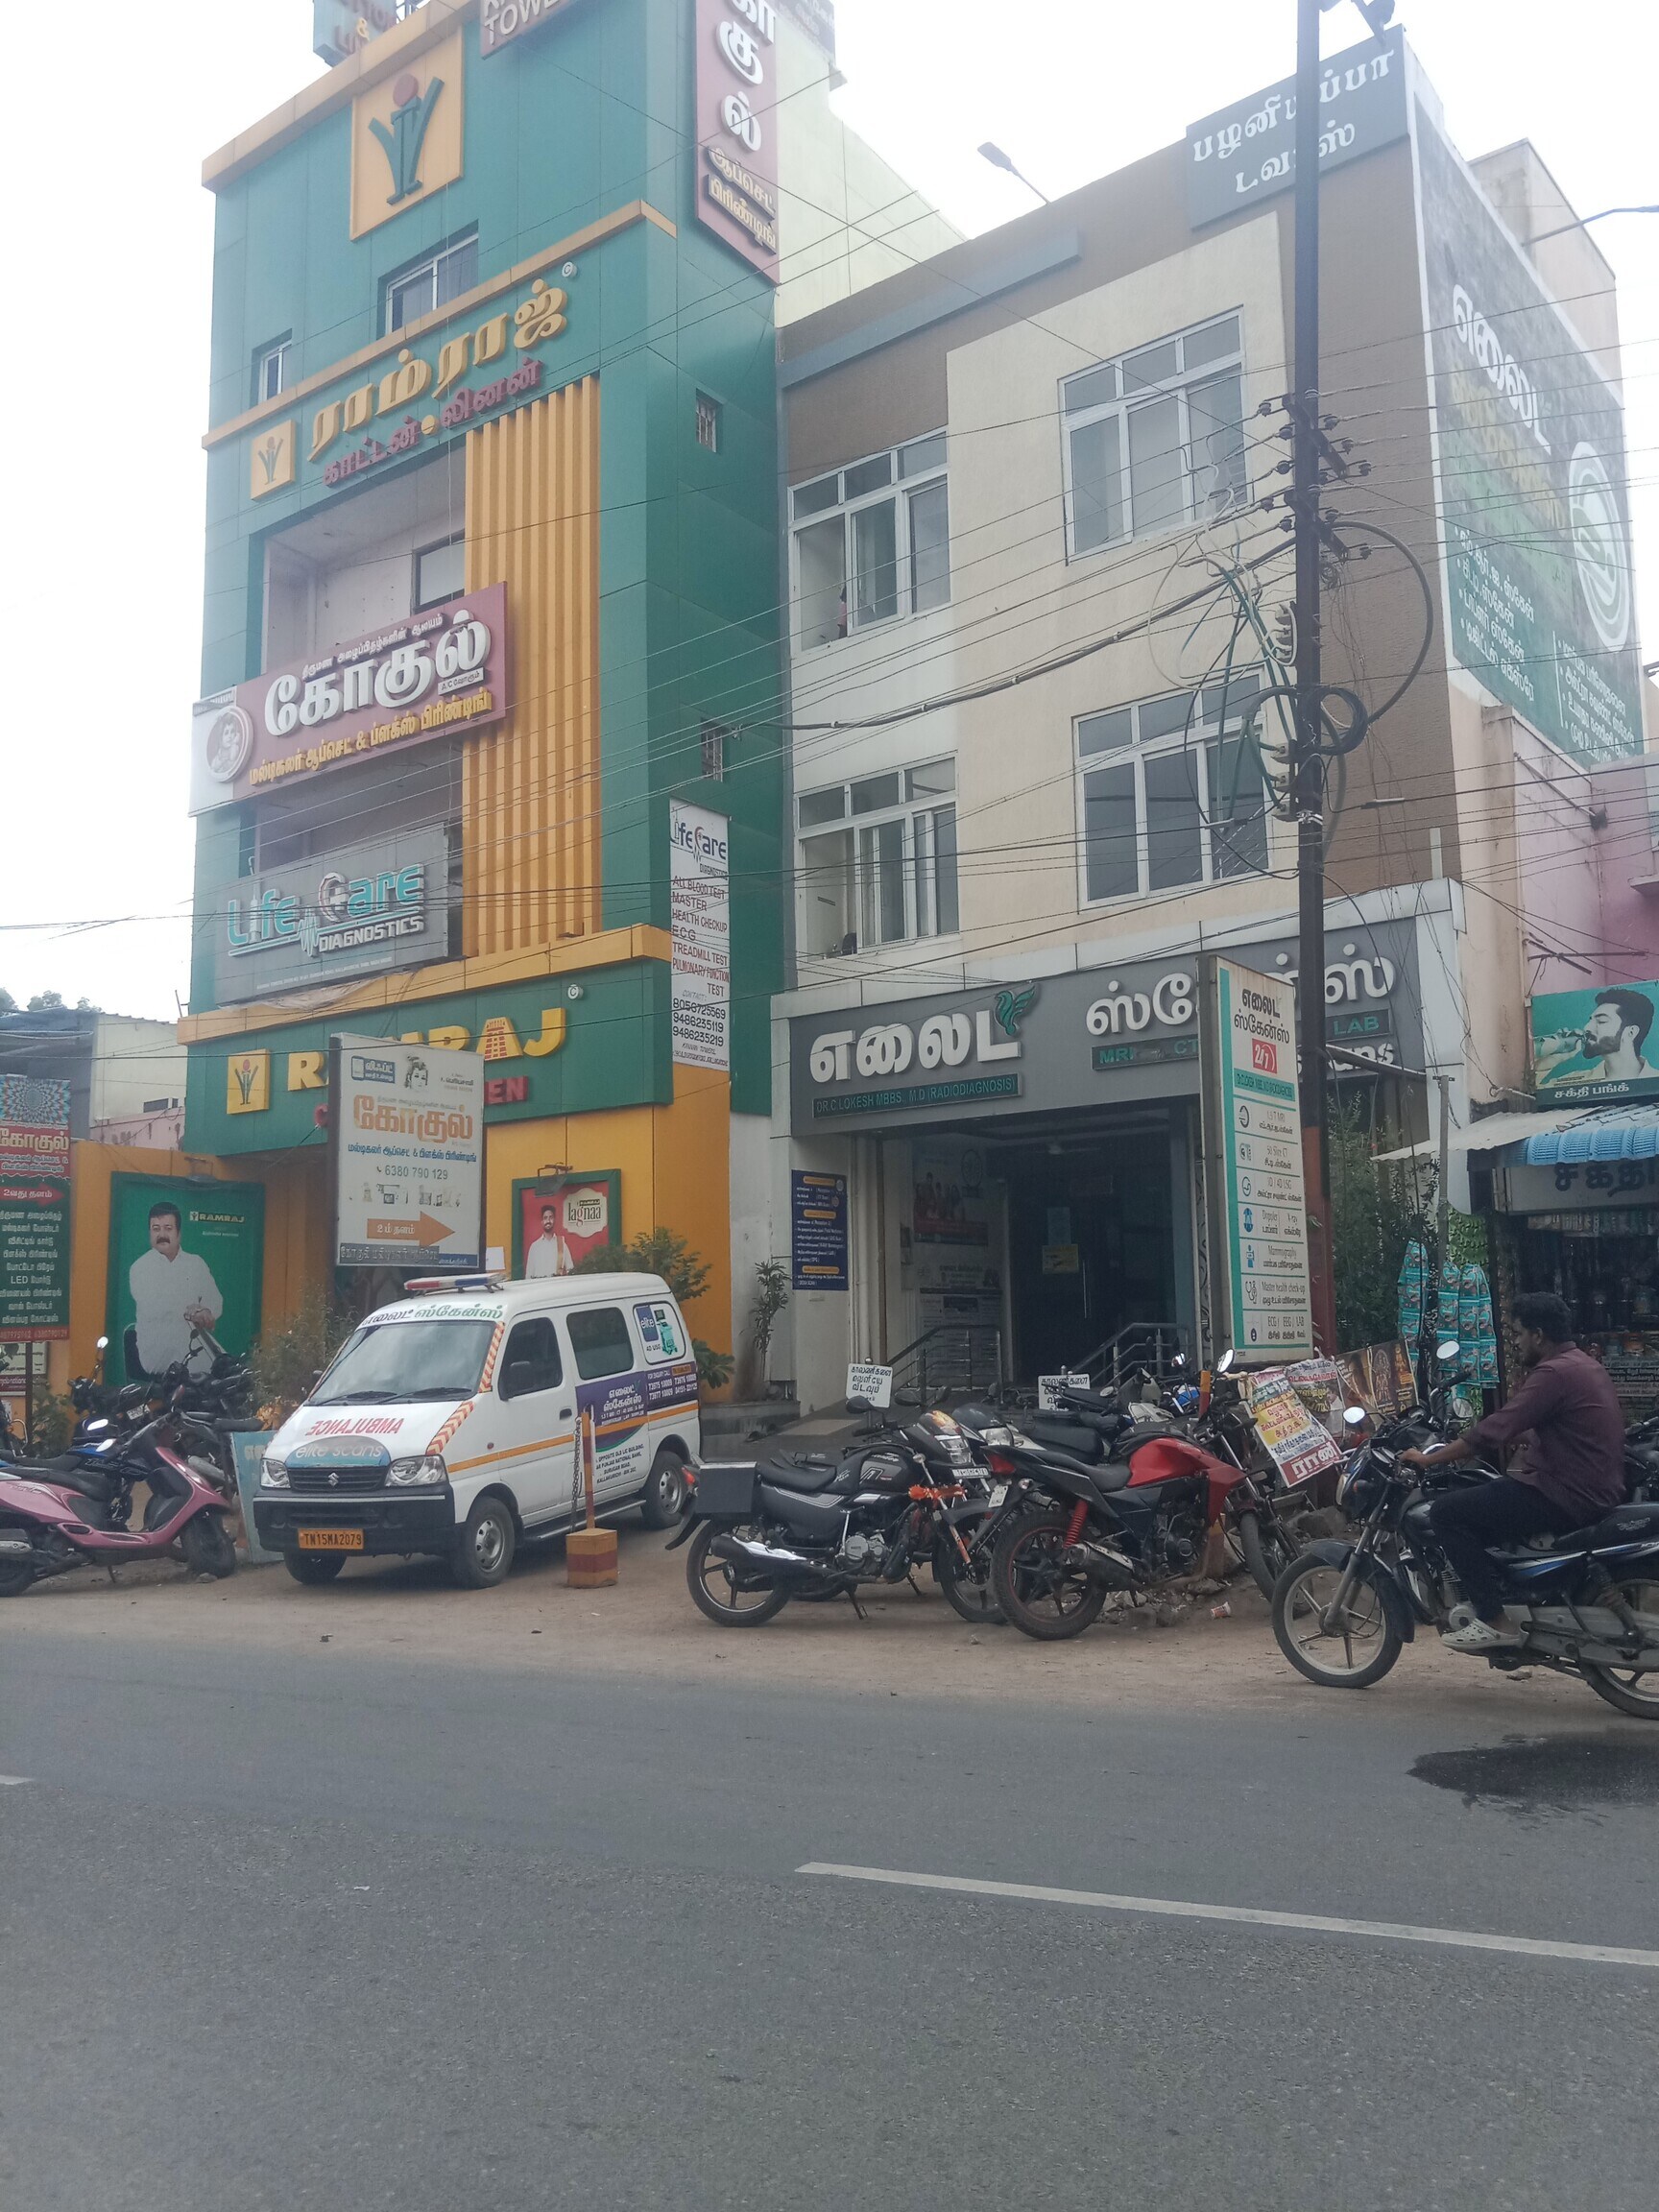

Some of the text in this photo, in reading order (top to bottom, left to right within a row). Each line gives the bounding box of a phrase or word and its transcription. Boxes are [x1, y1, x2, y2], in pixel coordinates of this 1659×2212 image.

[307, 278, 568, 463] ராம்ராஜ்
[265, 609, 491, 736] கோகுல்
[355, 730, 369, 749] &
[672, 891, 708, 911] MASTER
[710, 885, 726, 901] TEST
[672, 908, 727, 933] HEALTH CHECKUP
[318, 915, 424, 952] DIAGNOSTICS
[672, 926, 696, 941] ECG
[672, 941, 728, 966] TREADMILL TEST
[672, 957, 706, 976] PULMONARY
[707, 982, 725, 998] TEST
[673, 1012, 724, 1033] 9486235119
[1235, 1008, 1289, 1044] ஸ்கேன்ஸ்
[1334, 1016, 1380, 1036] LAB
[673, 1025, 724, 1047] 9486235219
[288, 1007, 566, 1093] RRAJ
[1553, 1083, 1589, 1099] சக்தி
[353, 1094, 473, 1143] கோகுல்
[413, 1148, 419, 1157] &
[385, 1165, 448, 1180] 6380 790 129
[199, 1213, 245, 1223] RAMRAJ
[567, 1202, 601, 1227] lagnaa
[11, 1275, 29, 1285] LED
[415, 1303, 503, 1319] ஸ்கேன்ஸ்
[296, 1444, 384, 1458] elite scans
[304, 1532, 362, 1546] TN15MA2079
